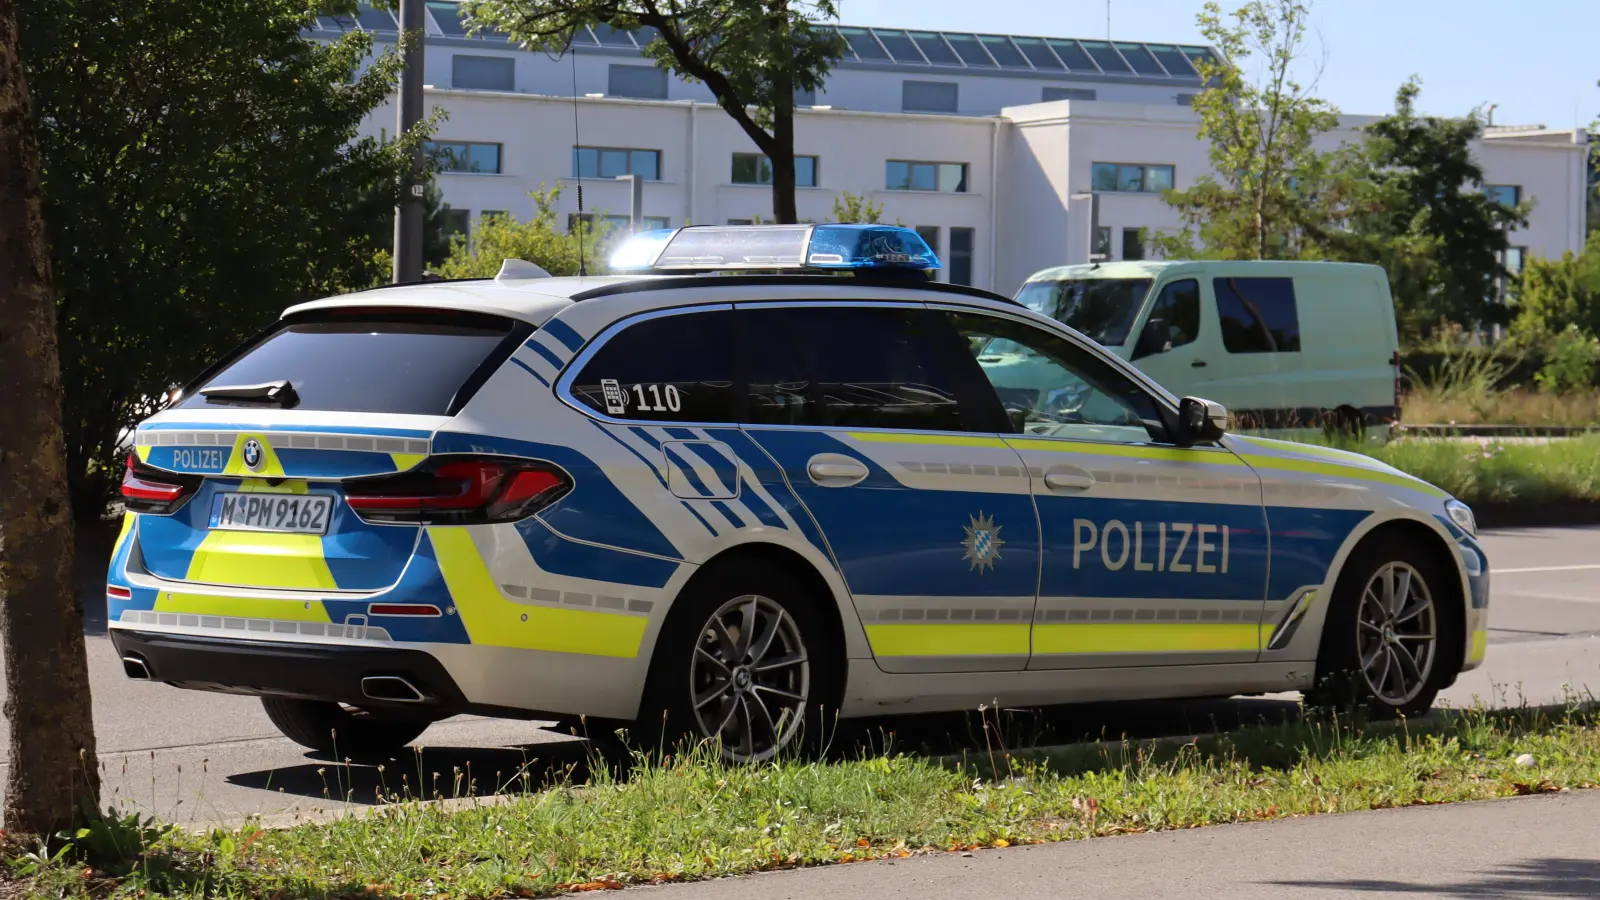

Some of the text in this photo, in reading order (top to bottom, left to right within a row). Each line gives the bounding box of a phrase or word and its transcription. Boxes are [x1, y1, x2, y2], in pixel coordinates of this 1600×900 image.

[632, 383, 681, 412] 110
[173, 450, 223, 469] POLIZEI
[220, 496, 326, 529] M PM 9162
[1073, 518, 1229, 573] POLIZEI
